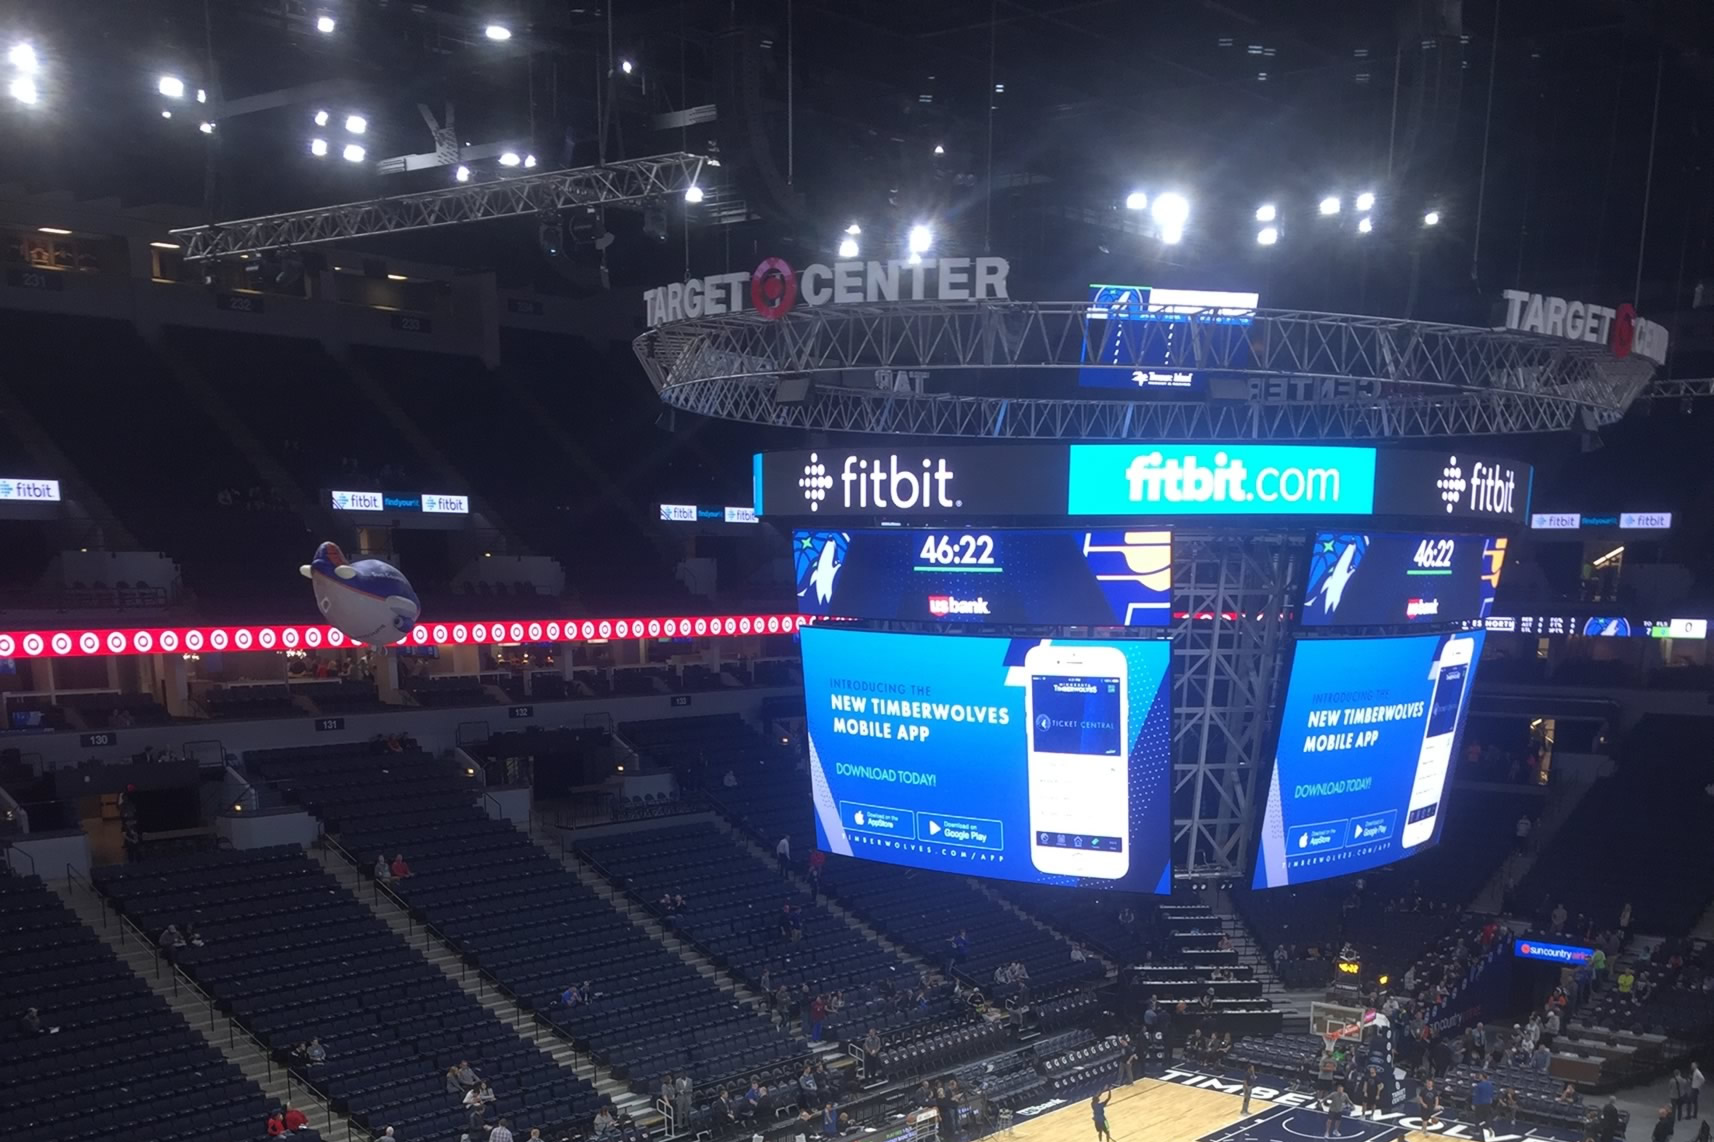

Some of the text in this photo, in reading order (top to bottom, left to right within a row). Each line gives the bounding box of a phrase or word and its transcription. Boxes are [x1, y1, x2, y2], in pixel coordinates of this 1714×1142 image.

[23, 273, 46, 287] 231
[644, 256, 1011, 328] TARGET CENTER
[231, 298, 251, 310] 232
[1503, 289, 1617, 345] TARGET
[1125, 451, 1341, 503] fitbit.com
[1470, 462, 1516, 514] fitbit
[919, 535, 995, 564] 46:22
[1413, 540, 1454, 568] 46:22
[830, 678, 932, 696] INTRODUCING THE
[1312, 690, 1373, 704] INTRODUCING
[831, 694, 1010, 725] NEW TIMBERWOLVES
[1308, 701, 1425, 728] NEW TIMBERWOLVES
[322, 720, 337, 729] 131
[833, 717, 930, 742] MOBILE APP
[1052, 720, 1114, 730] TICKET CENTRAL
[90, 735, 108, 745] 130
[1303, 730, 1379, 752] MOBILE APP
[836, 762, 937, 787] DOWNLOAD TODAY!
[1295, 777, 1372, 799] DOWNLOAD TODAY!
[842, 832, 1004, 863] TIMBERWOLVES.COM/APP
[944, 828, 987, 844] Google Play
